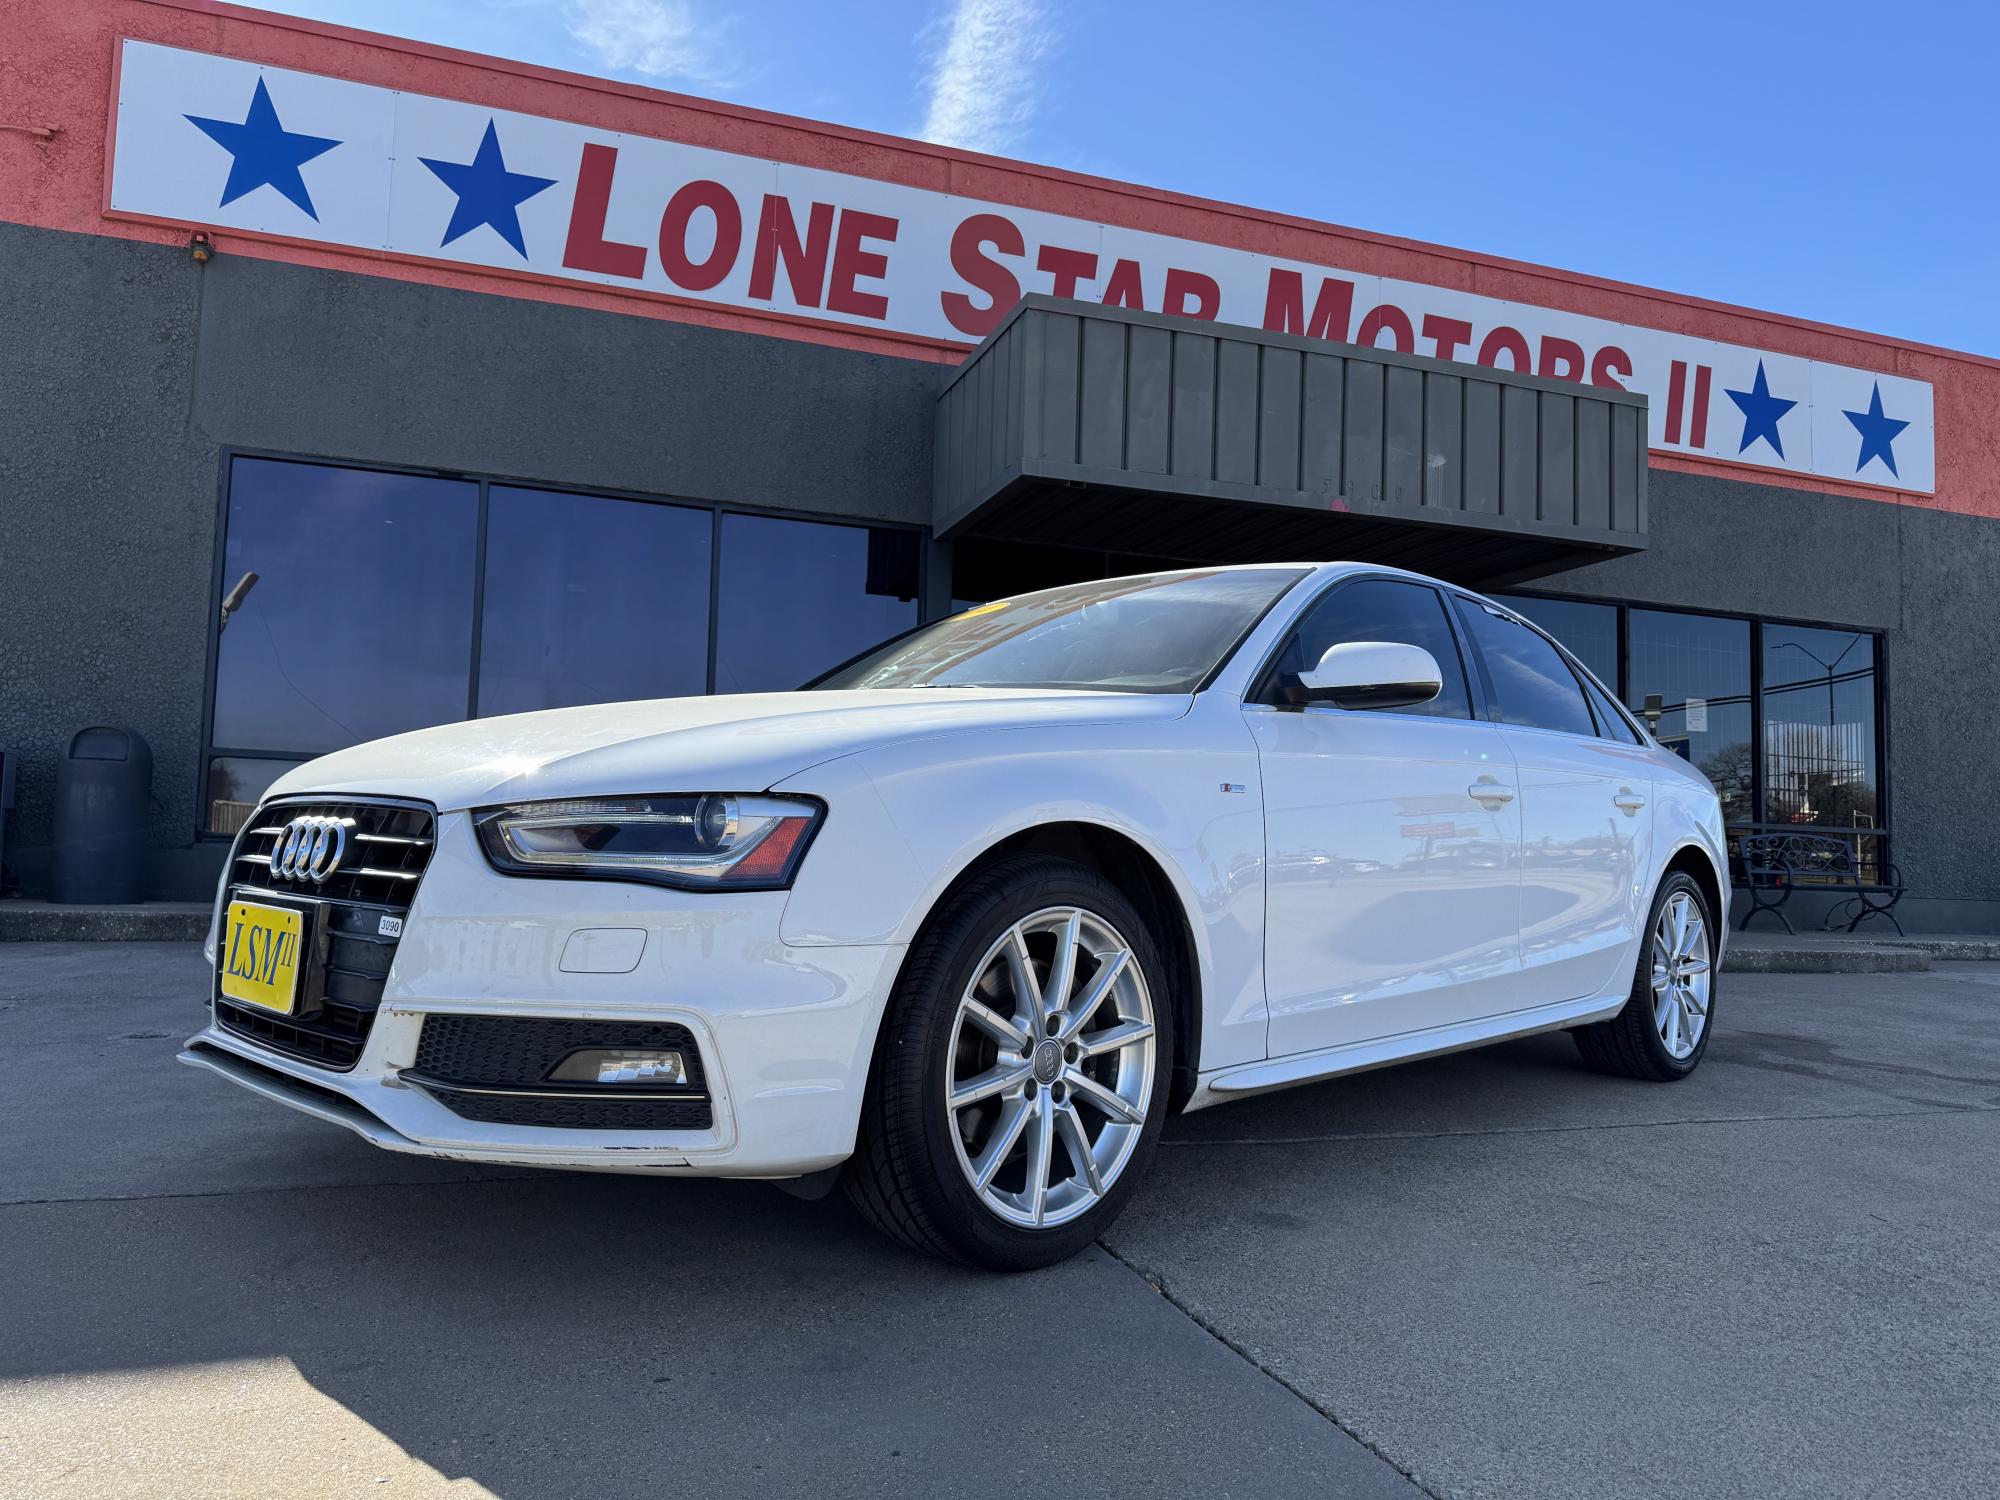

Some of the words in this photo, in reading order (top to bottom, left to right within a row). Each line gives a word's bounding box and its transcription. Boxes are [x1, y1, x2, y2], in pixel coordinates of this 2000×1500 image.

[562, 142, 899, 320] LONE
[1663, 360, 1711, 449] II
[381, 919, 400, 933] 3090
